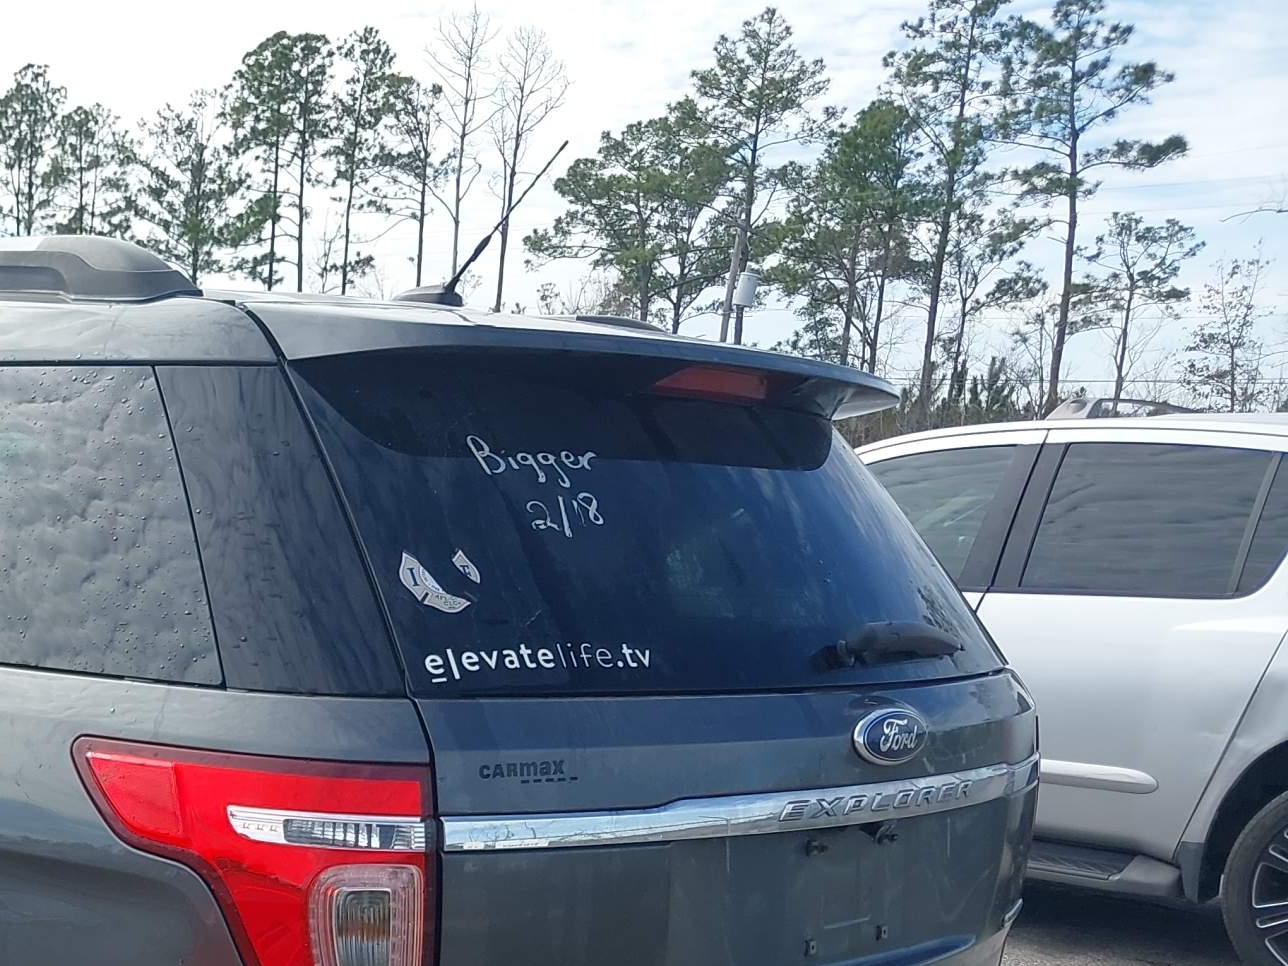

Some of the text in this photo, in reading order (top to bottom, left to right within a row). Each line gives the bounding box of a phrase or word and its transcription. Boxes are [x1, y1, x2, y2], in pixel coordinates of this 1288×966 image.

[466, 435, 597, 488] Bigger
[526, 492, 604, 538] 2/18
[424, 643, 650, 682] elevatelife.tv
[880, 718, 918, 752] Ford
[778, 779, 974, 822] EXPLORER
